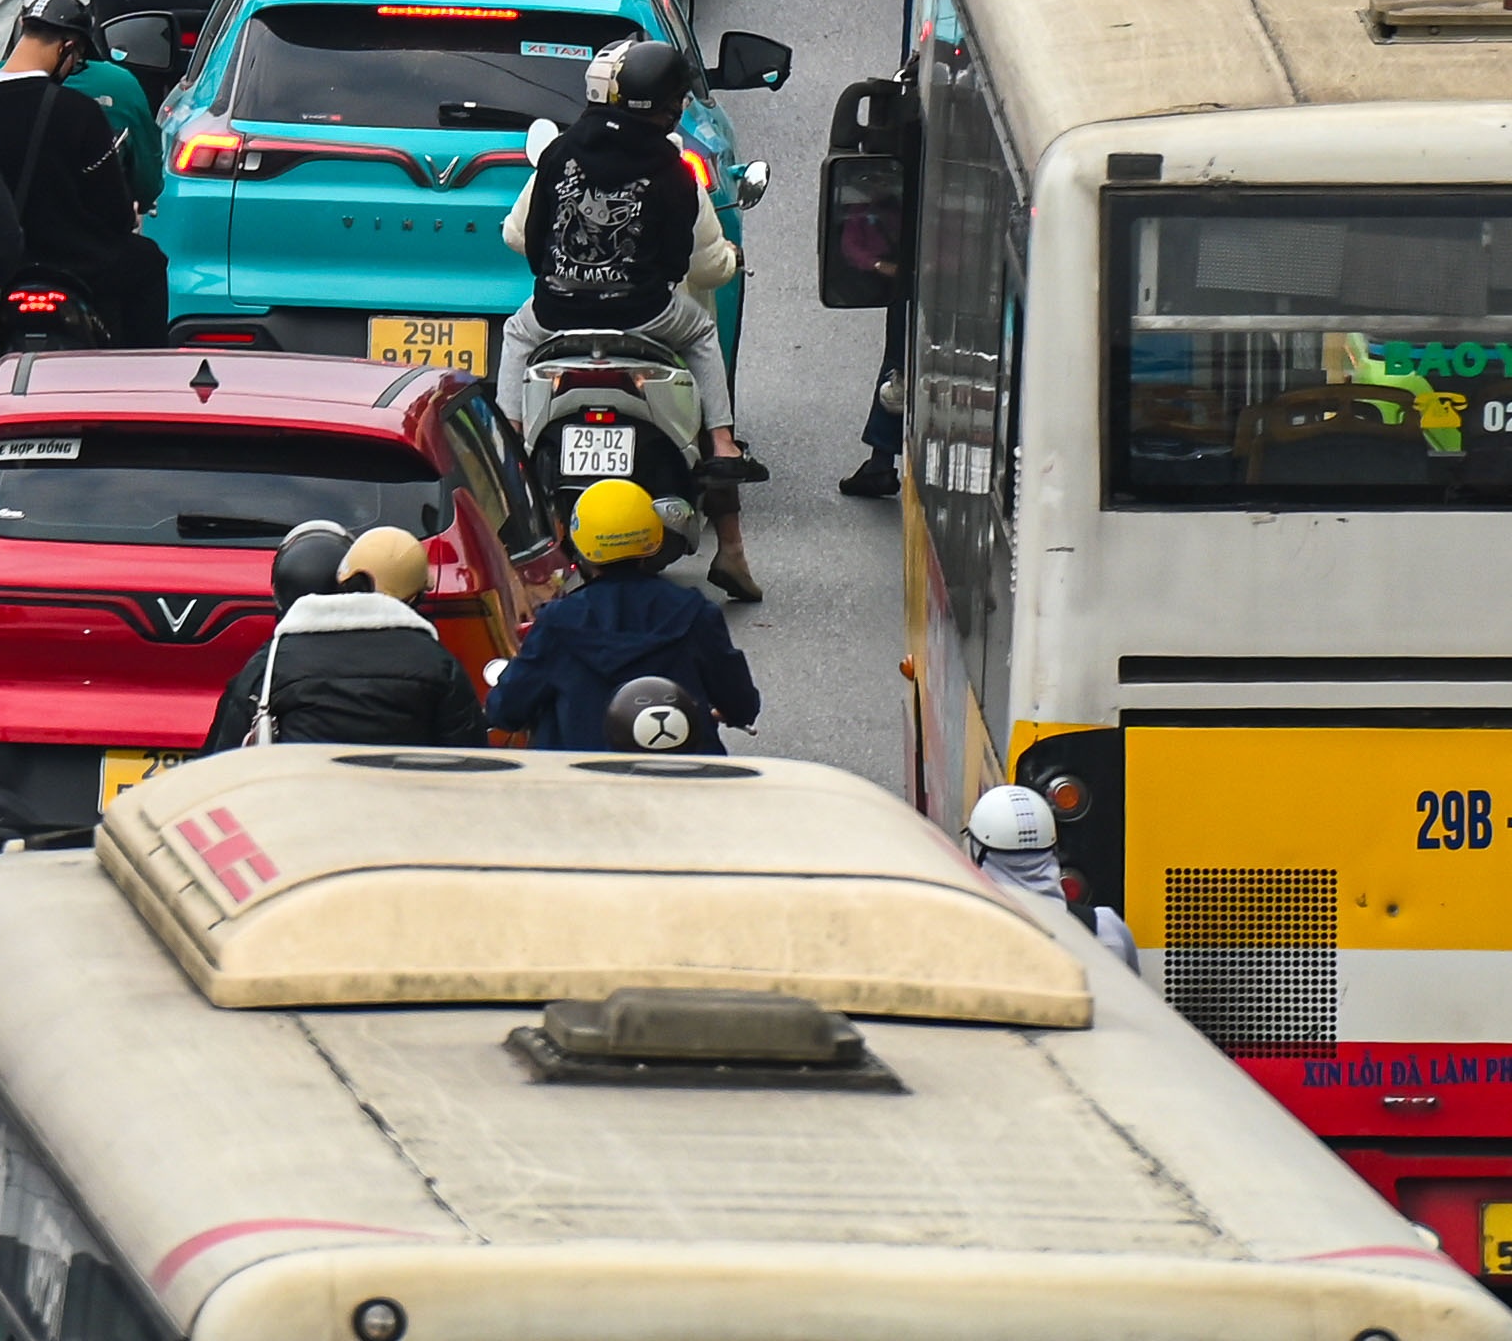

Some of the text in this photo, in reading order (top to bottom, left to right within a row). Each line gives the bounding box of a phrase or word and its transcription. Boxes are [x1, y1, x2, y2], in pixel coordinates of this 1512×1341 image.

[528, 44, 586, 57] XE TAXI
[404, 321, 454, 345] 29H
[1383, 341, 1487, 379] BAO
[9, 442, 34, 456] HỢP
[37, 438, 72, 454] ĐỒNG
[568, 452, 629, 472] 170.59
[1416, 789, 1492, 850] 29B
[1303, 1062, 1341, 1086] XIN
[1430, 1054, 1478, 1084] LÀM
